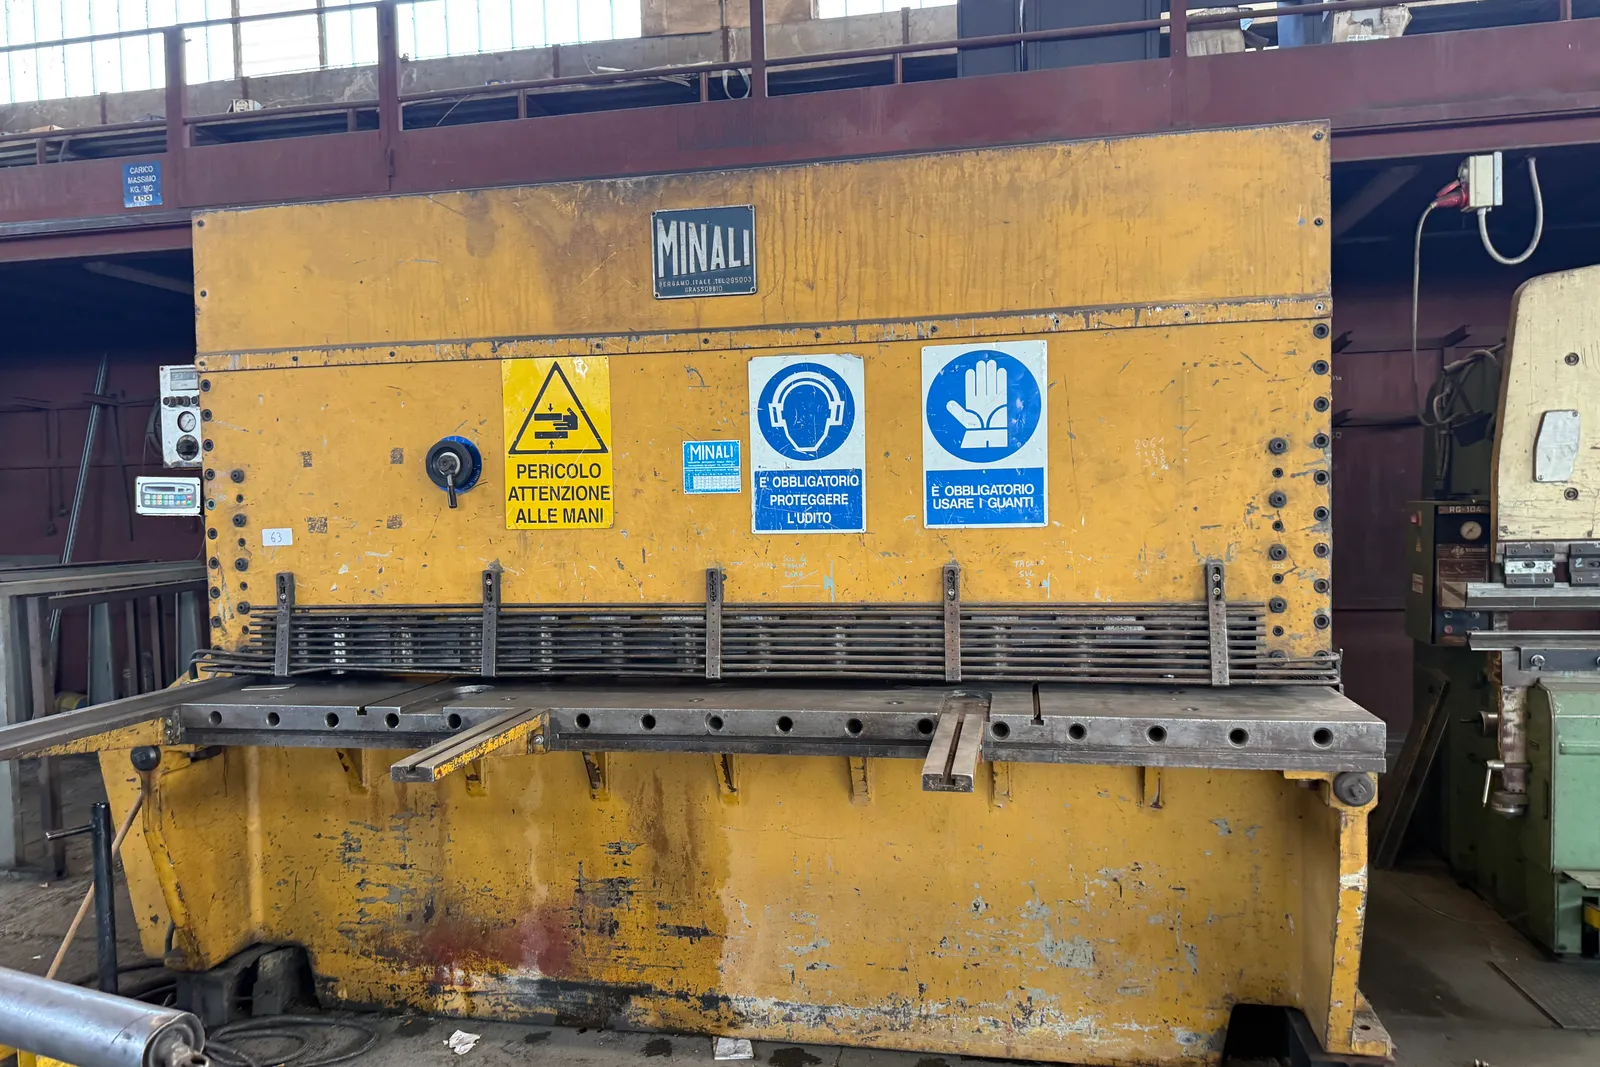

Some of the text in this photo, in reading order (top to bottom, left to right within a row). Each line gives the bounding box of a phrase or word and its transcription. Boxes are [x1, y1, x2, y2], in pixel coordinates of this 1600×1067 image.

[130, 166, 153, 174] CARICO
[128, 175, 156, 184] MASSIMO
[657, 219, 750, 278] MINALI
[689, 444, 733, 461] MINALI
[517, 463, 602, 479] PERICOLO
[772, 475, 859, 487] OBBLIGATORIO
[508, 486, 610, 501] ATTENZIONE
[944, 484, 1034, 496] OBBLIGATORIO
[770, 494, 849, 506] PROTEGGERE
[933, 497, 1034, 509] USARE I GUANTI
[516, 508, 603, 523] ALLE MANI
[787, 512, 831, 524] L'UDITO
[270, 532, 282, 542] 63
